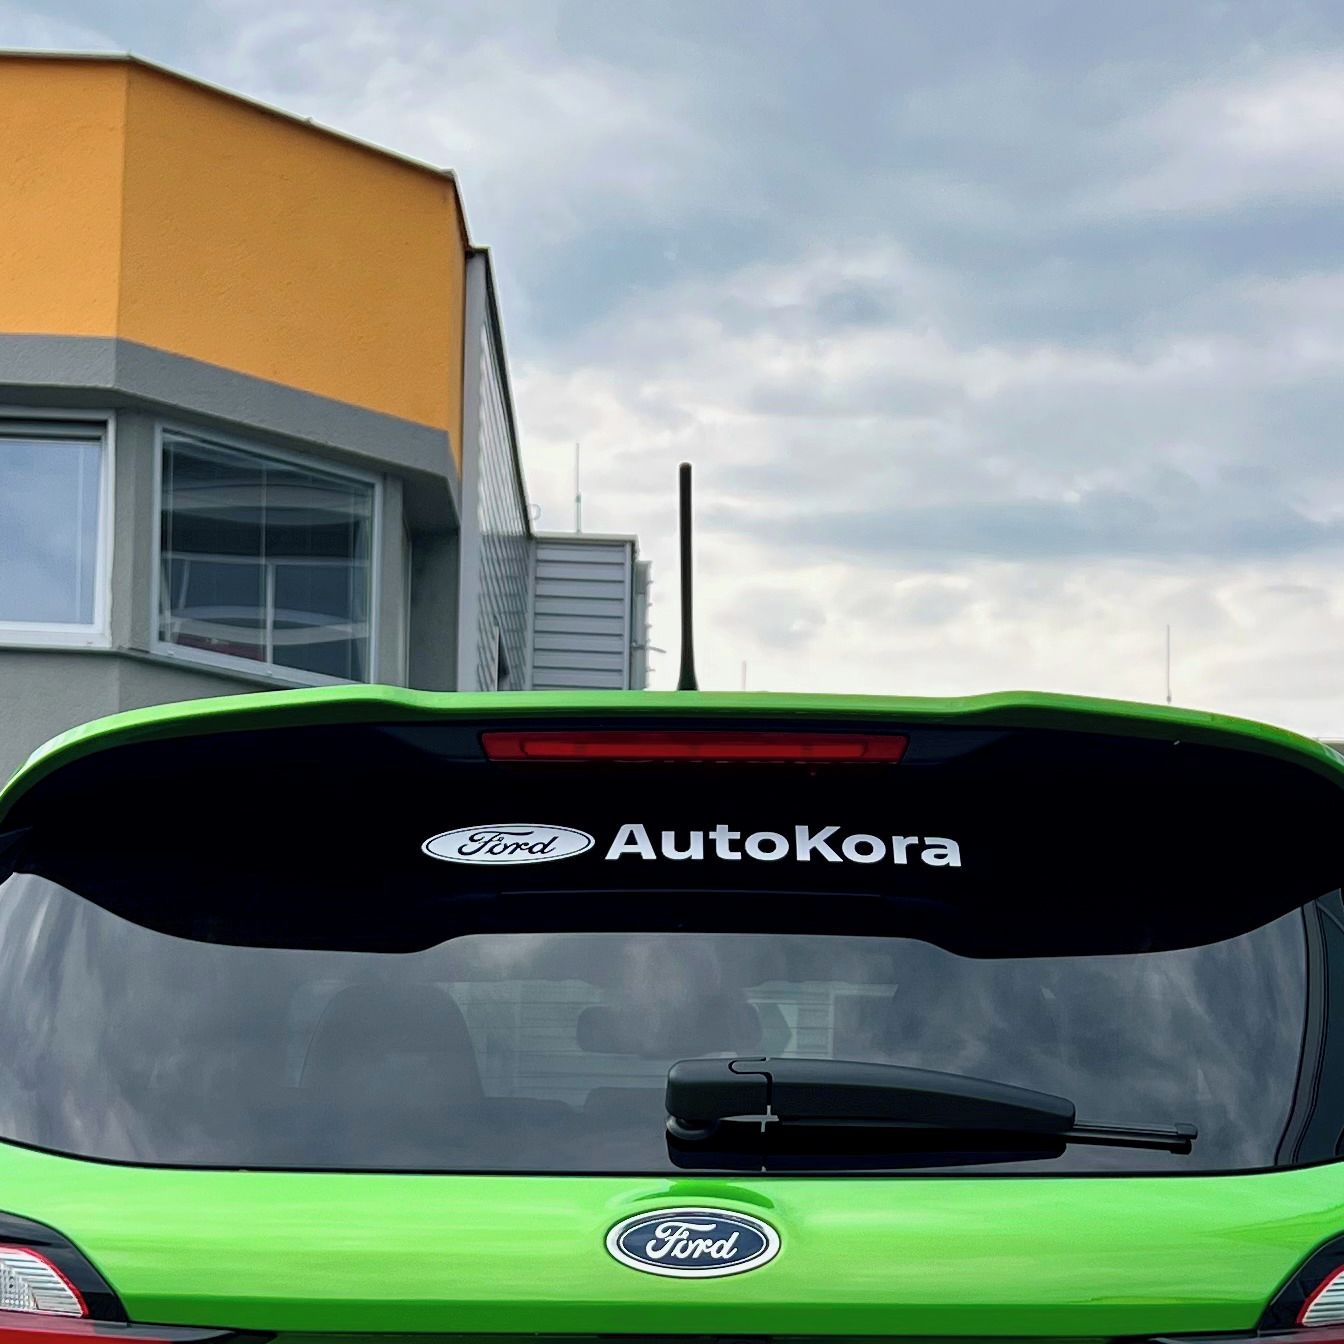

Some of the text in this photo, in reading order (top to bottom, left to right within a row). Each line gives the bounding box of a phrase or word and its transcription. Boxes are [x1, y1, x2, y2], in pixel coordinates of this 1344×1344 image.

[457, 823, 962, 867] Ford AutoKora
[646, 1221, 738, 1262] Ford
